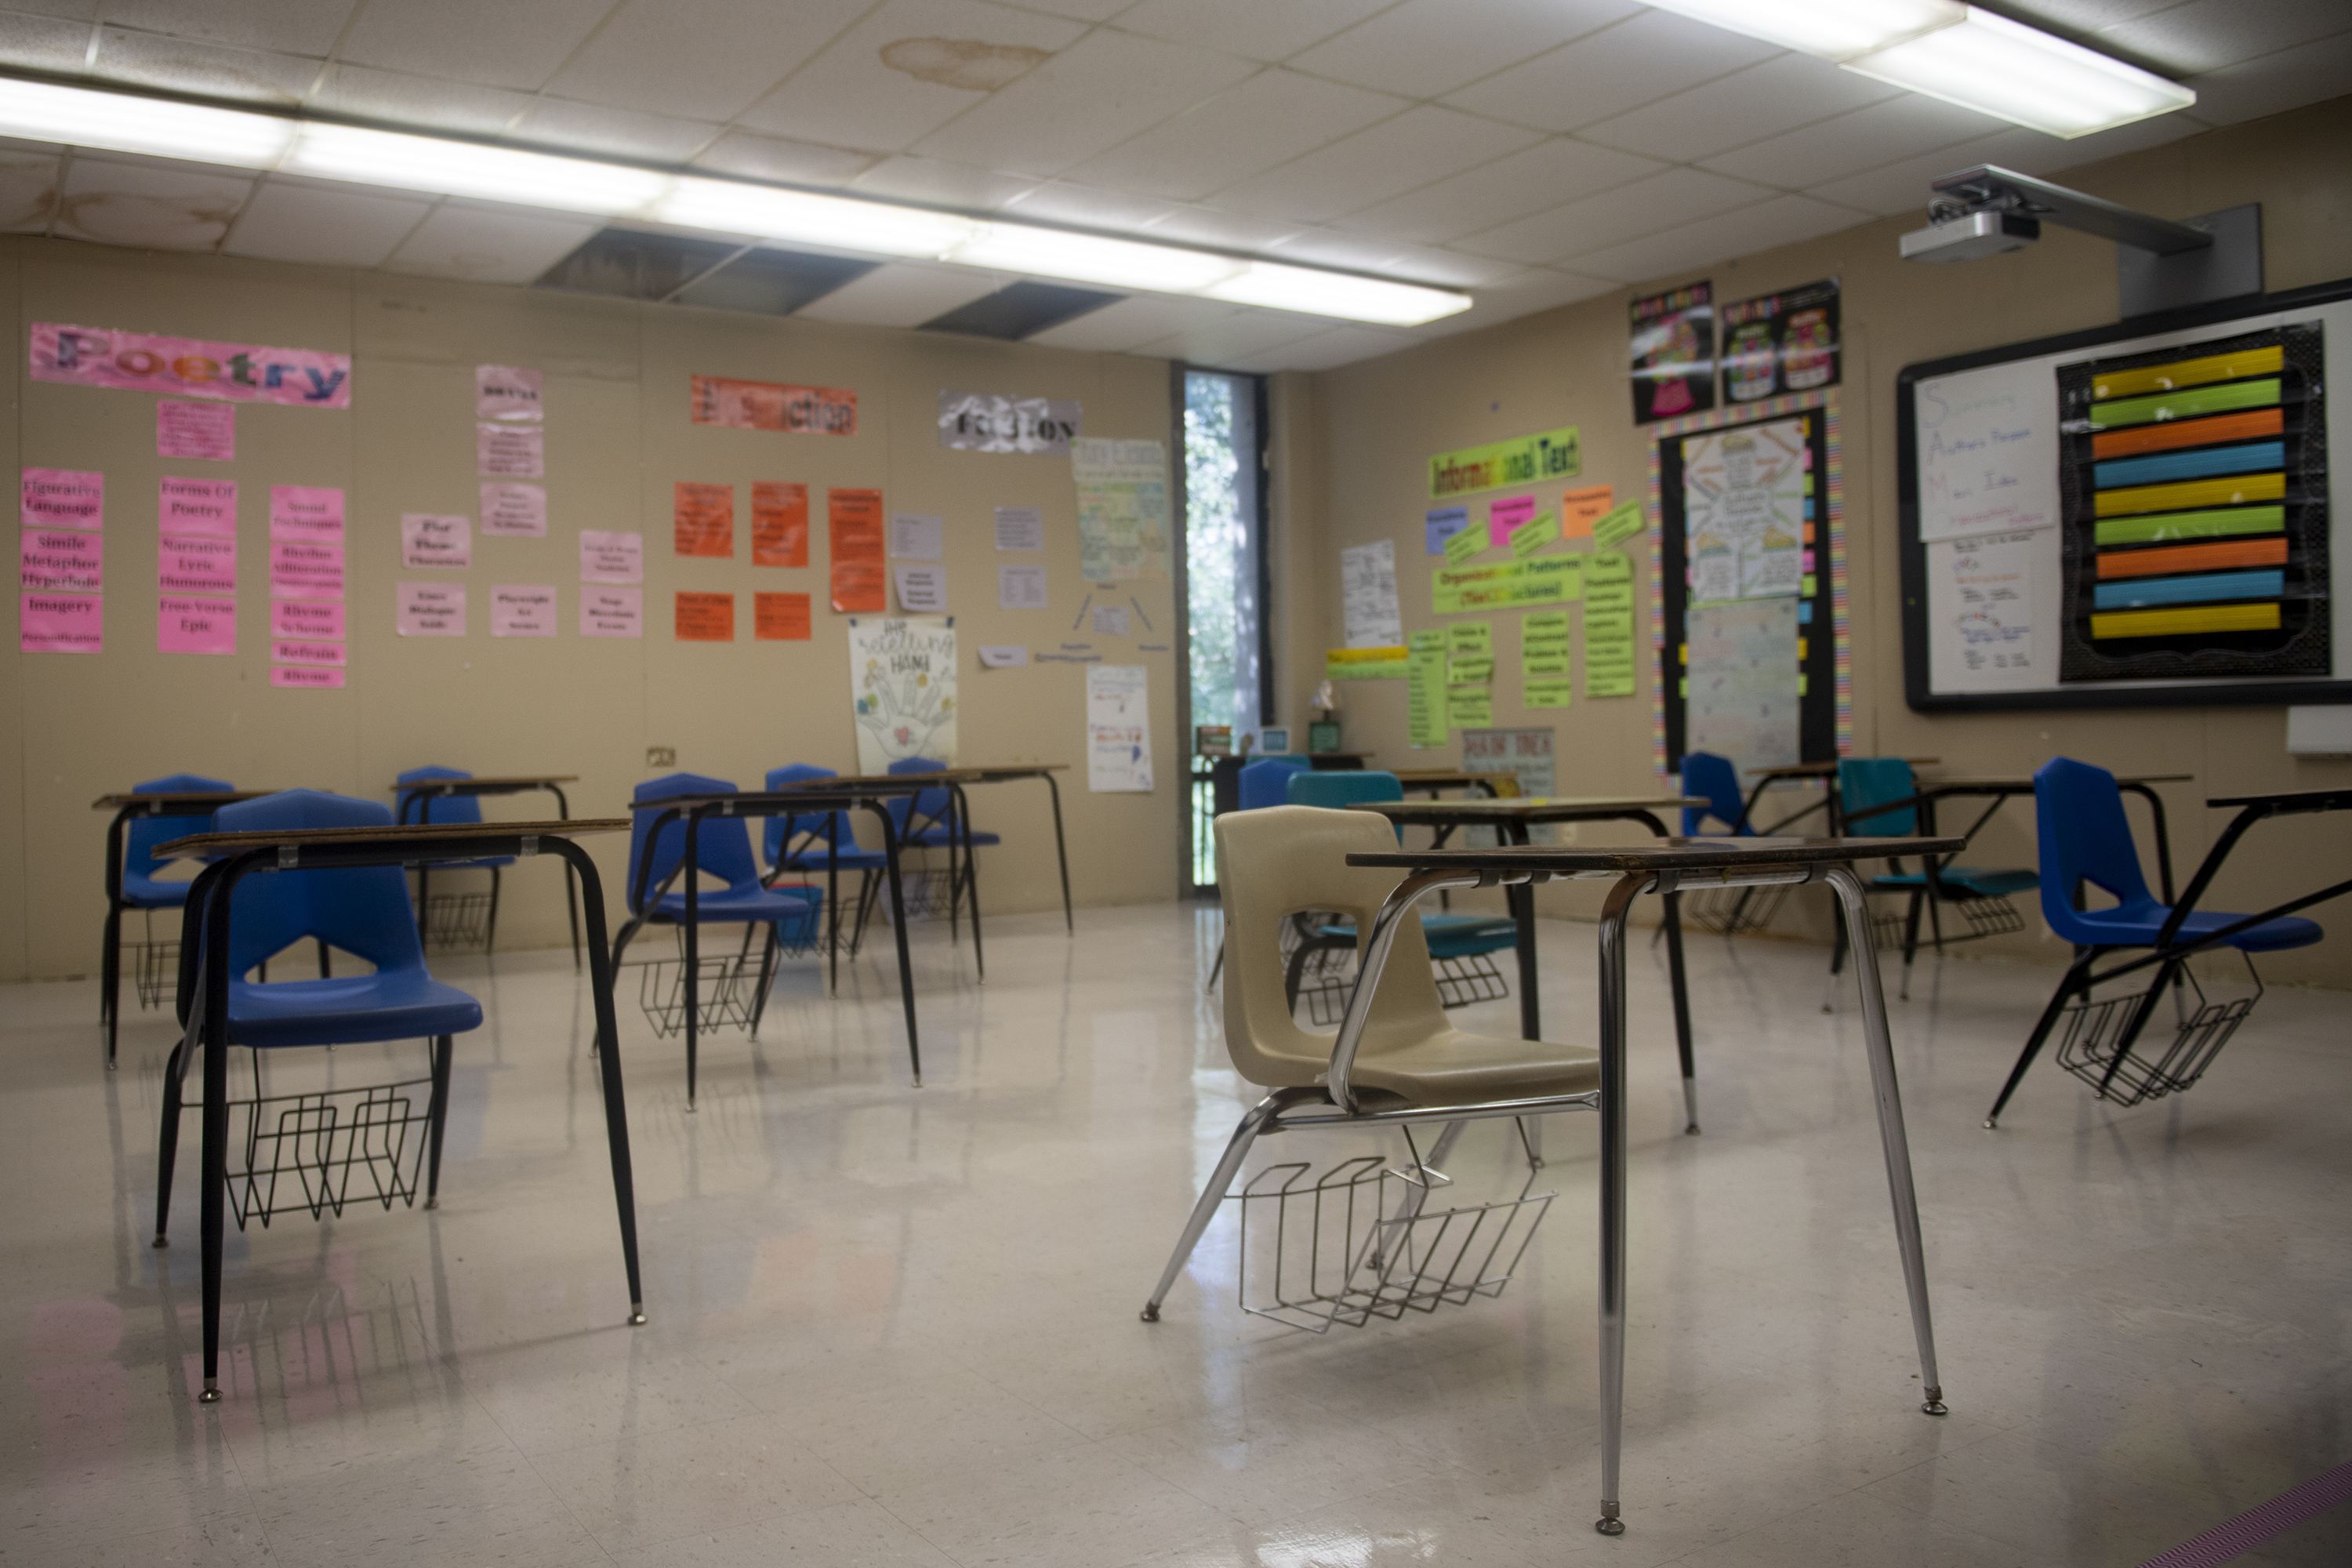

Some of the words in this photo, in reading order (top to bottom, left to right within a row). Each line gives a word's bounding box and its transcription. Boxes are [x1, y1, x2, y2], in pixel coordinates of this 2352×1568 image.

[58, 331, 347, 401] Poetry
[956, 412, 1077, 442] FITION
[23, 481, 101, 499] Figurative
[162, 482, 210, 497] Forms
[26, 498, 98, 517] Language
[171, 503, 223, 518] Poetry
[38, 535, 86, 551] Simile
[163, 539, 232, 554] Narrative
[23, 553, 99, 572] Metaphor
[179, 557, 215, 572] Lyric
[22, 574, 100, 590] Hyperbole
[160, 576, 234, 590] Humorous
[28, 598, 93, 615] Imagery
[180, 619, 212, 634] Epic
[22, 633, 100, 644] Personification
